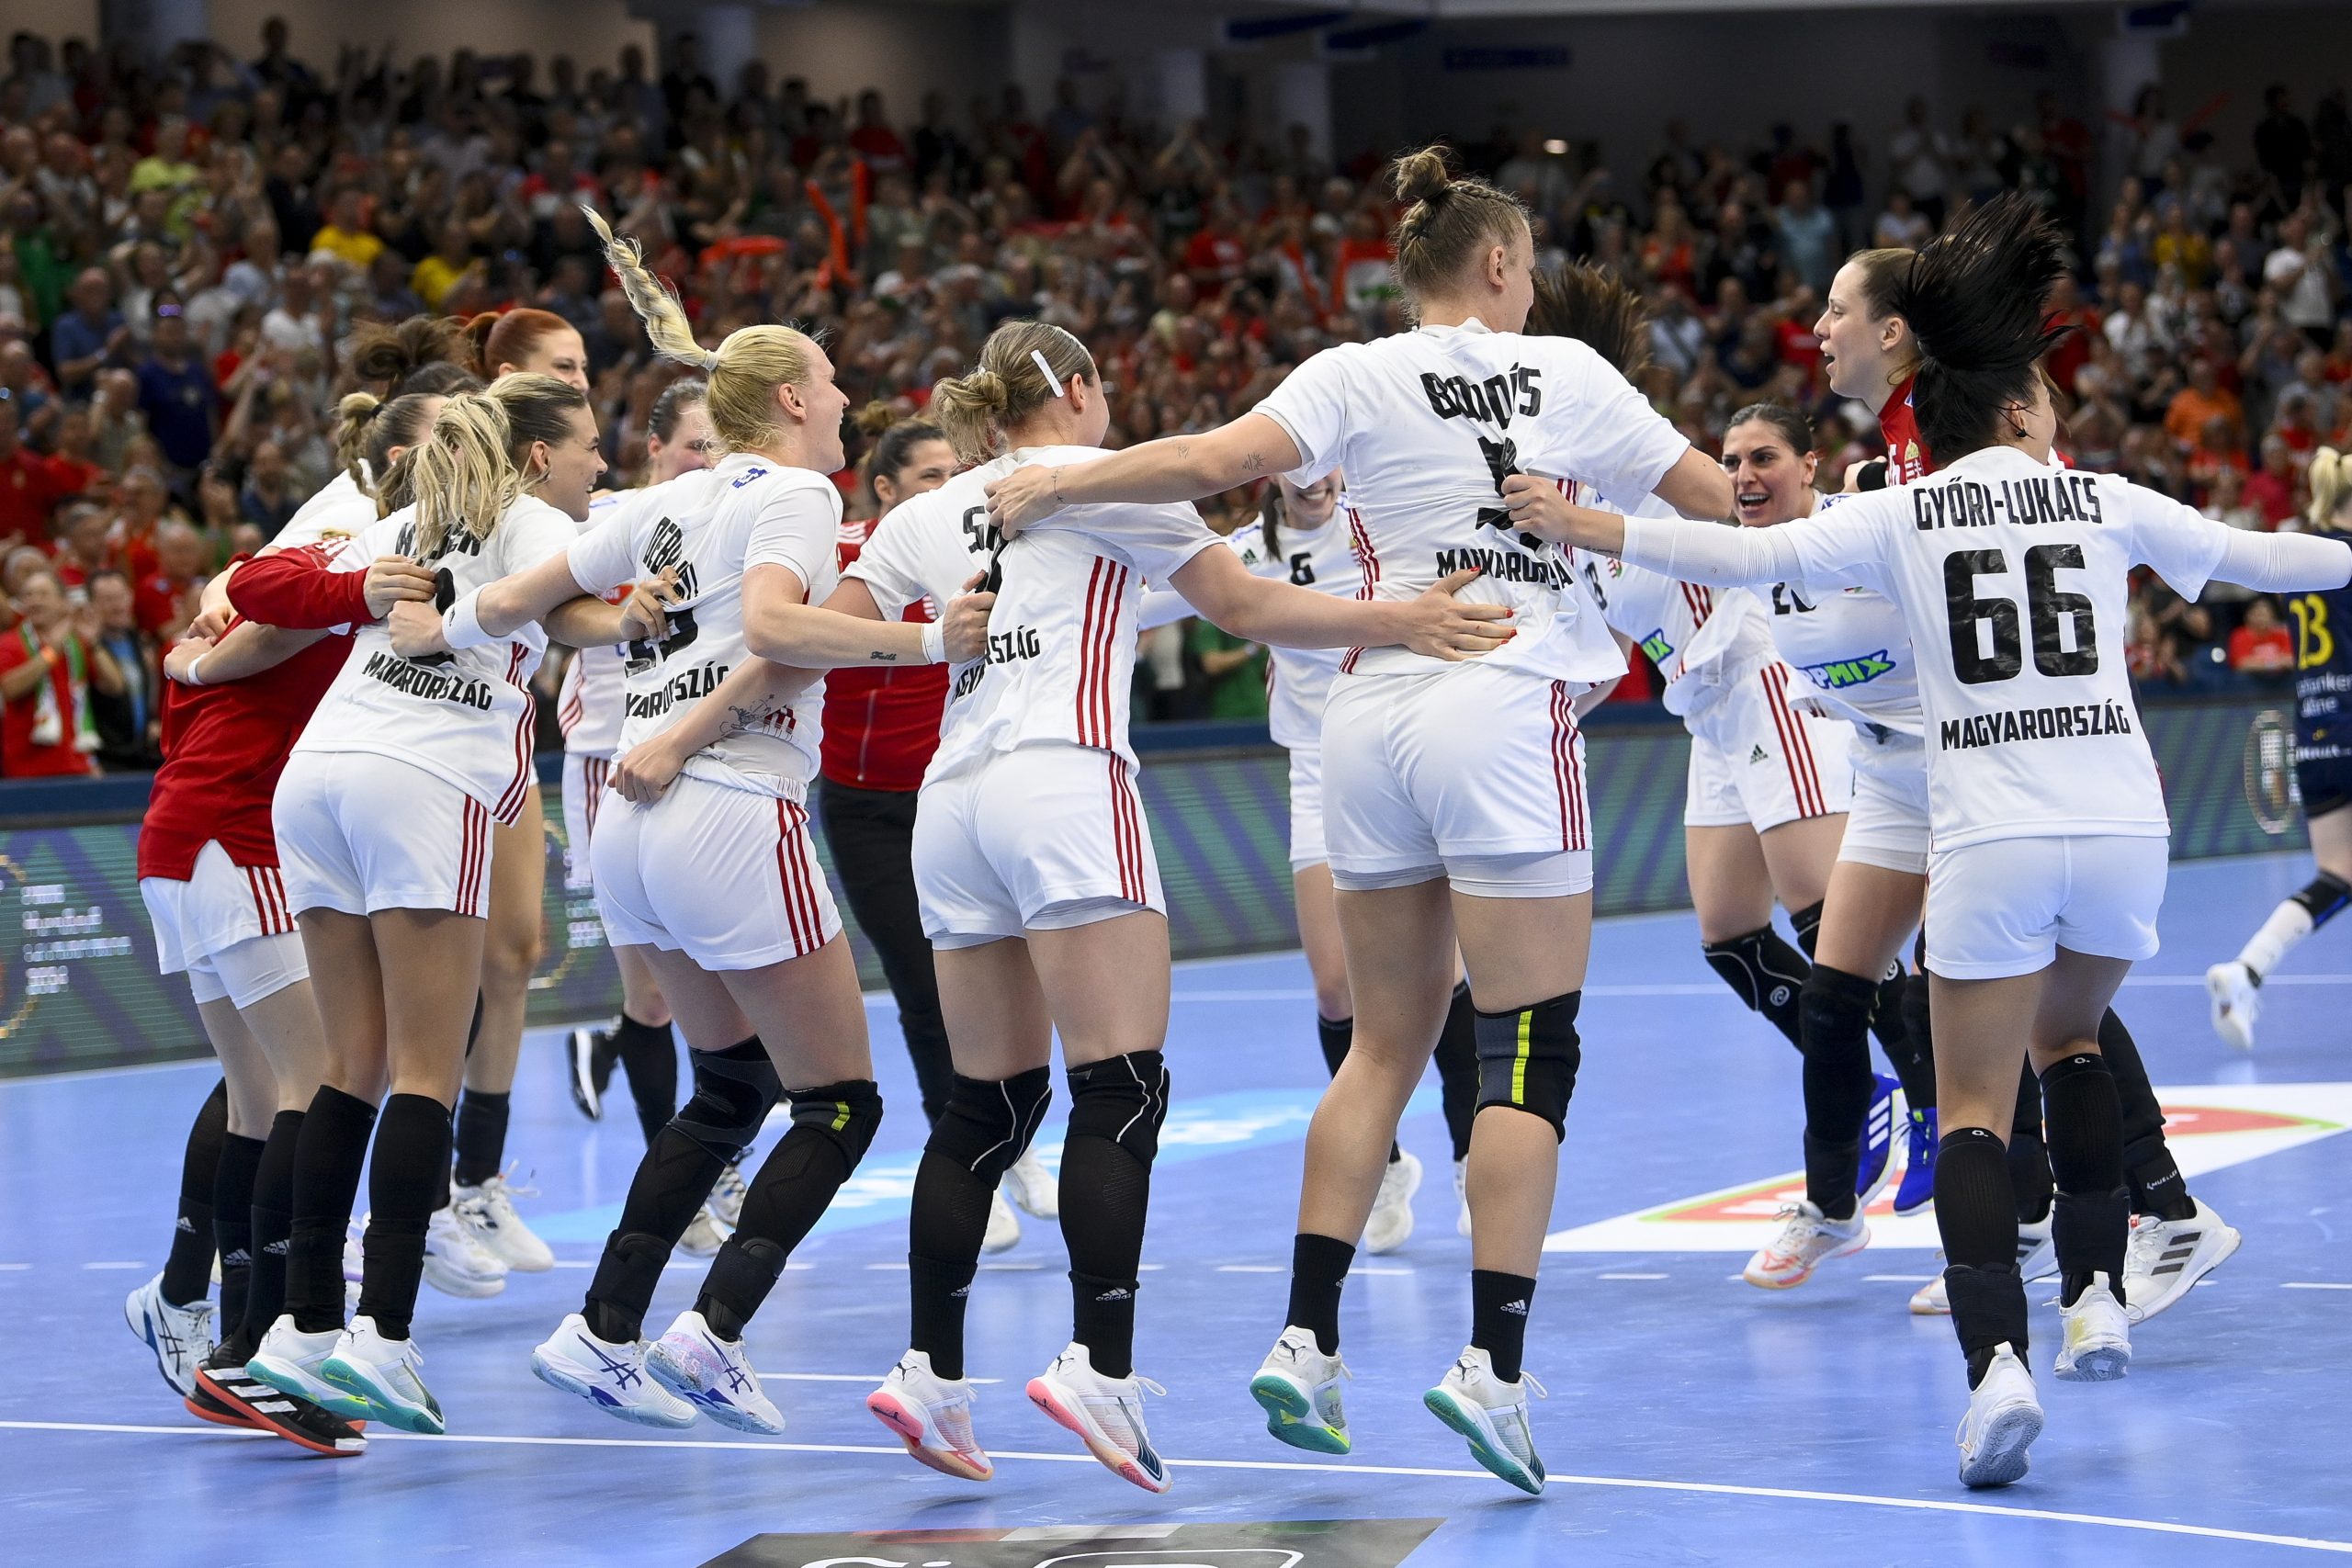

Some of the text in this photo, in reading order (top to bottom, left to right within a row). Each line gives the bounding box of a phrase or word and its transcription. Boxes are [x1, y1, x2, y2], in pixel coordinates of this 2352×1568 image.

[1913, 470, 2103, 531] GYŐRI-LUKÁCS
[1290, 552, 1316, 586] 6
[1943, 544, 2100, 686] 66
[870, 650, 897, 661] Faith
[1940, 698, 2132, 751] MAGYARORSZÁG
